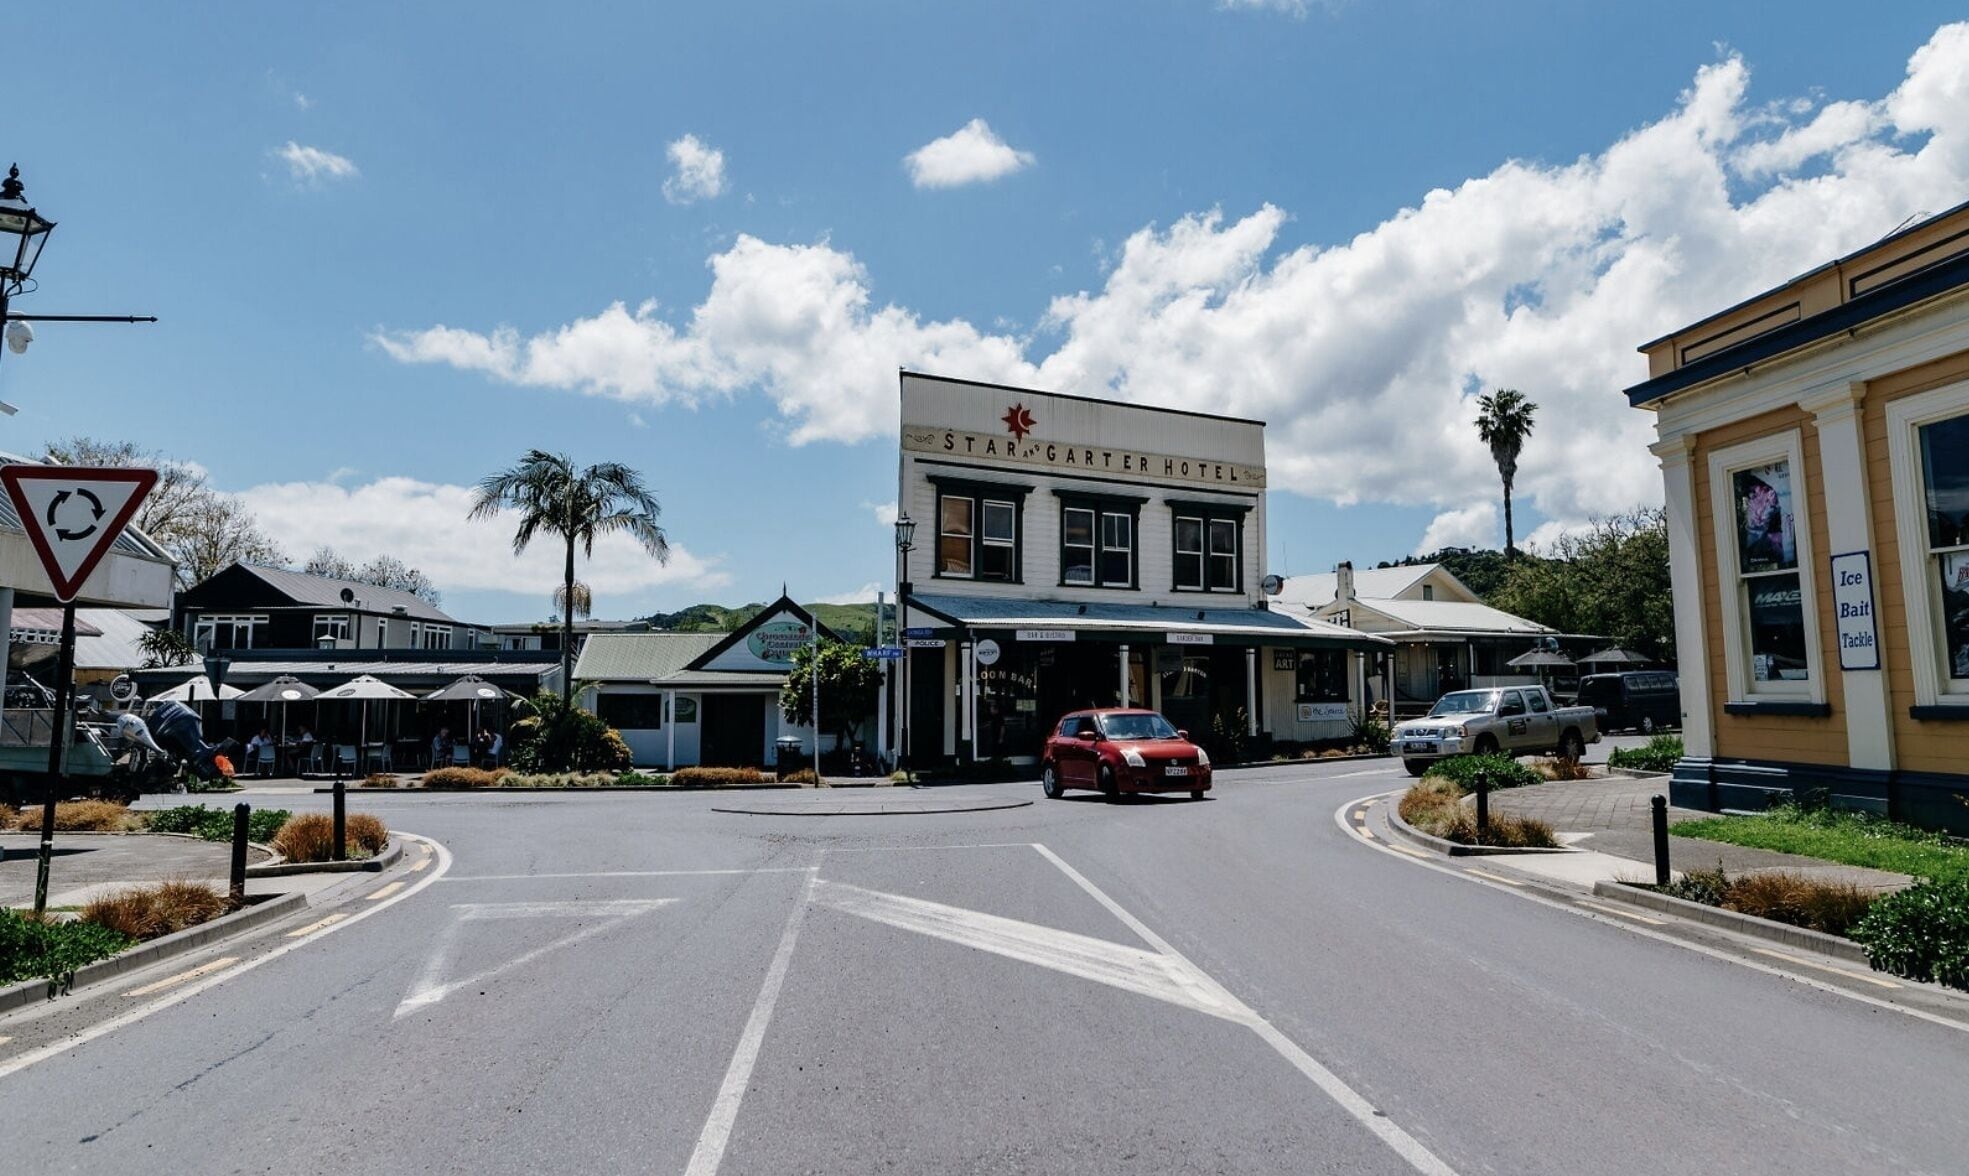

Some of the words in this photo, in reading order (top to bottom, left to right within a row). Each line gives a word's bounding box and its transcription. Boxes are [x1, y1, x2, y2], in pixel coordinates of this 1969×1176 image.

[944, 432, 1016, 457] STAR
[1047, 444, 1148, 472] GARTER
[1165, 458, 1238, 481] HOTEL
[1840, 571, 1862, 587] Ice
[1840, 600, 1870, 618] Bait
[1842, 631, 1874, 648] Tackle
[866, 648, 891, 658] WHARF
[1275, 659, 1294, 669] ART
